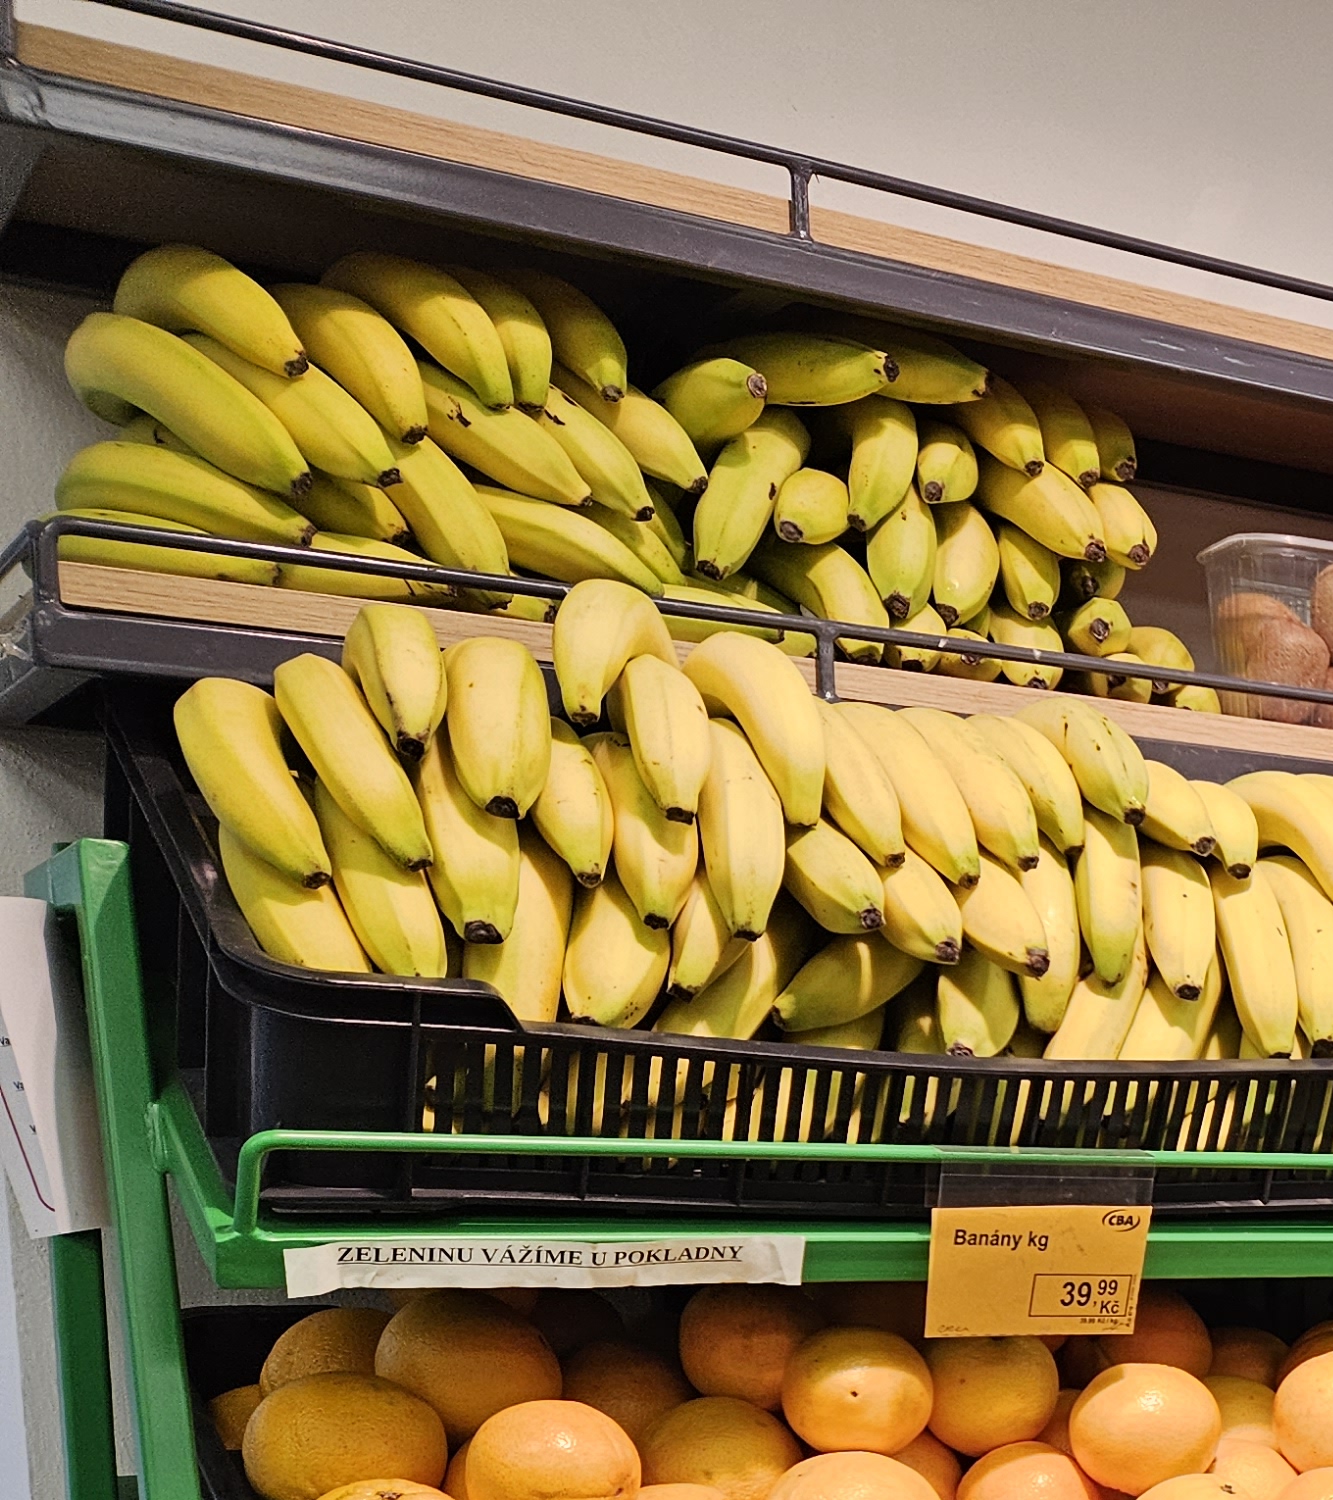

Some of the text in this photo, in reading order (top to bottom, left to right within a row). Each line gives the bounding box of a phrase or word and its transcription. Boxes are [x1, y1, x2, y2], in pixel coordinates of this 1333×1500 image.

[1108, 1215, 1133, 1226] CBA
[953, 1229, 1049, 1251] Banány kg
[337, 1244, 745, 1267] ZELENINU VÁŽÍME U POKLADNY
[1097, 1279, 1118, 1295] 99
[1099, 1300, 1119, 1314] Kč
